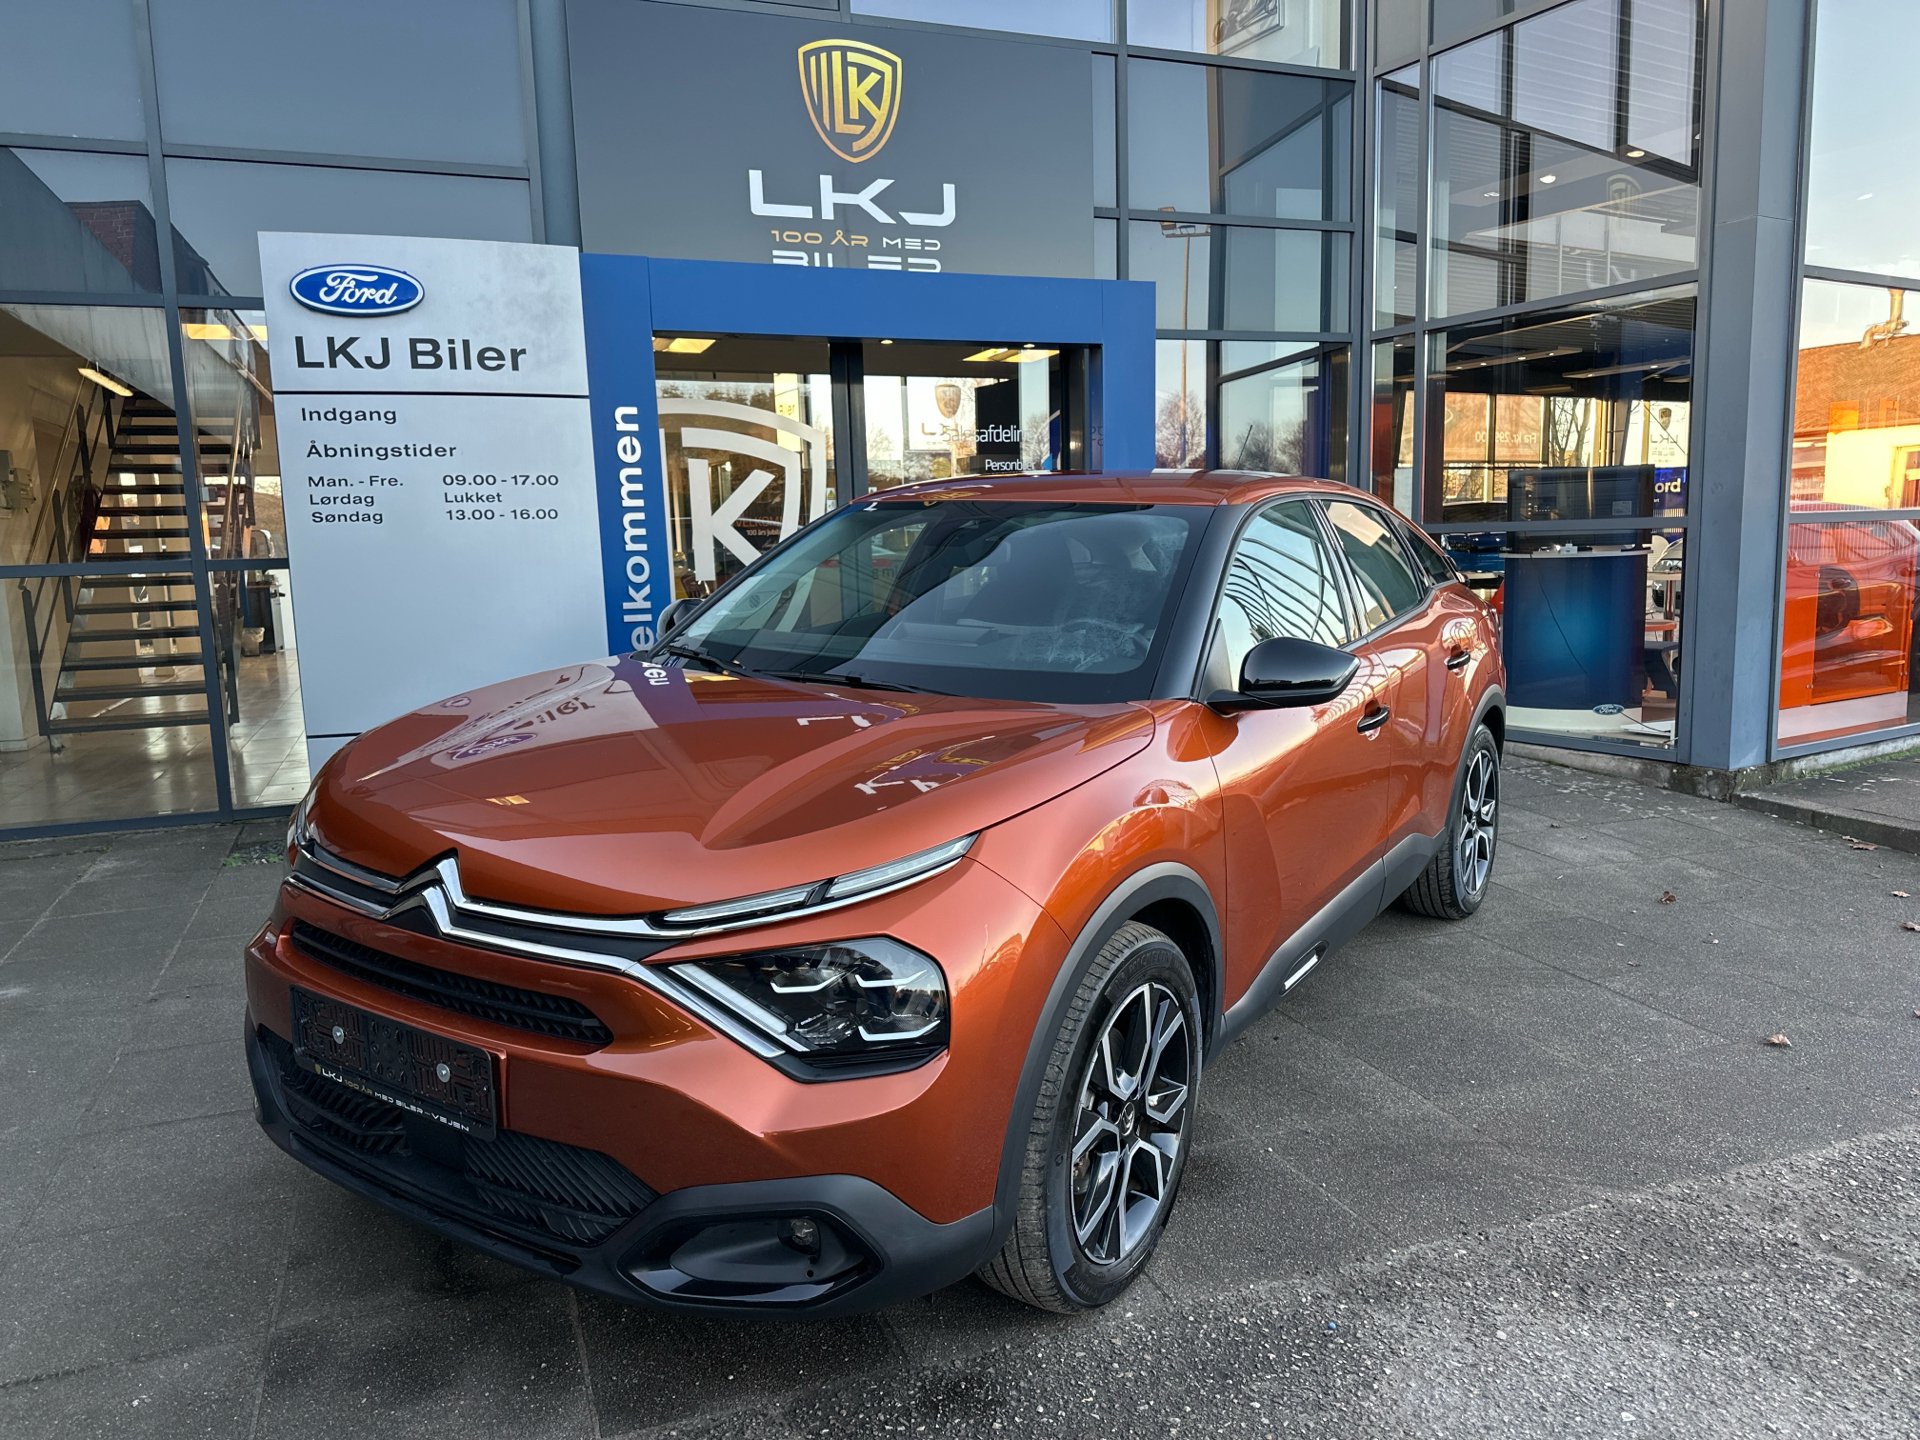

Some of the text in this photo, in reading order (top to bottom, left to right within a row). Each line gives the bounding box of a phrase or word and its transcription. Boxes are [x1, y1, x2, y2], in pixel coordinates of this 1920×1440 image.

[748, 169, 956, 227] LKJ
[771, 229, 941, 251] 100 ÅR MED
[319, 271, 398, 305] Ford
[294, 335, 527, 372] LKJ Biler
[301, 407, 397, 425] Indgang
[306, 439, 457, 461] Åbningstider
[308, 476, 354, 488] Man.
[369, 475, 404, 487] Fre.
[1654, 477, 1681, 493] ord
[309, 491, 503, 507] Lørdag Lukket
[311, 510, 383, 525] Søndag
[614, 405, 655, 652] elkommen
[321, 1068, 343, 1083] LKJ
[374, 1091, 394, 1103] MED
